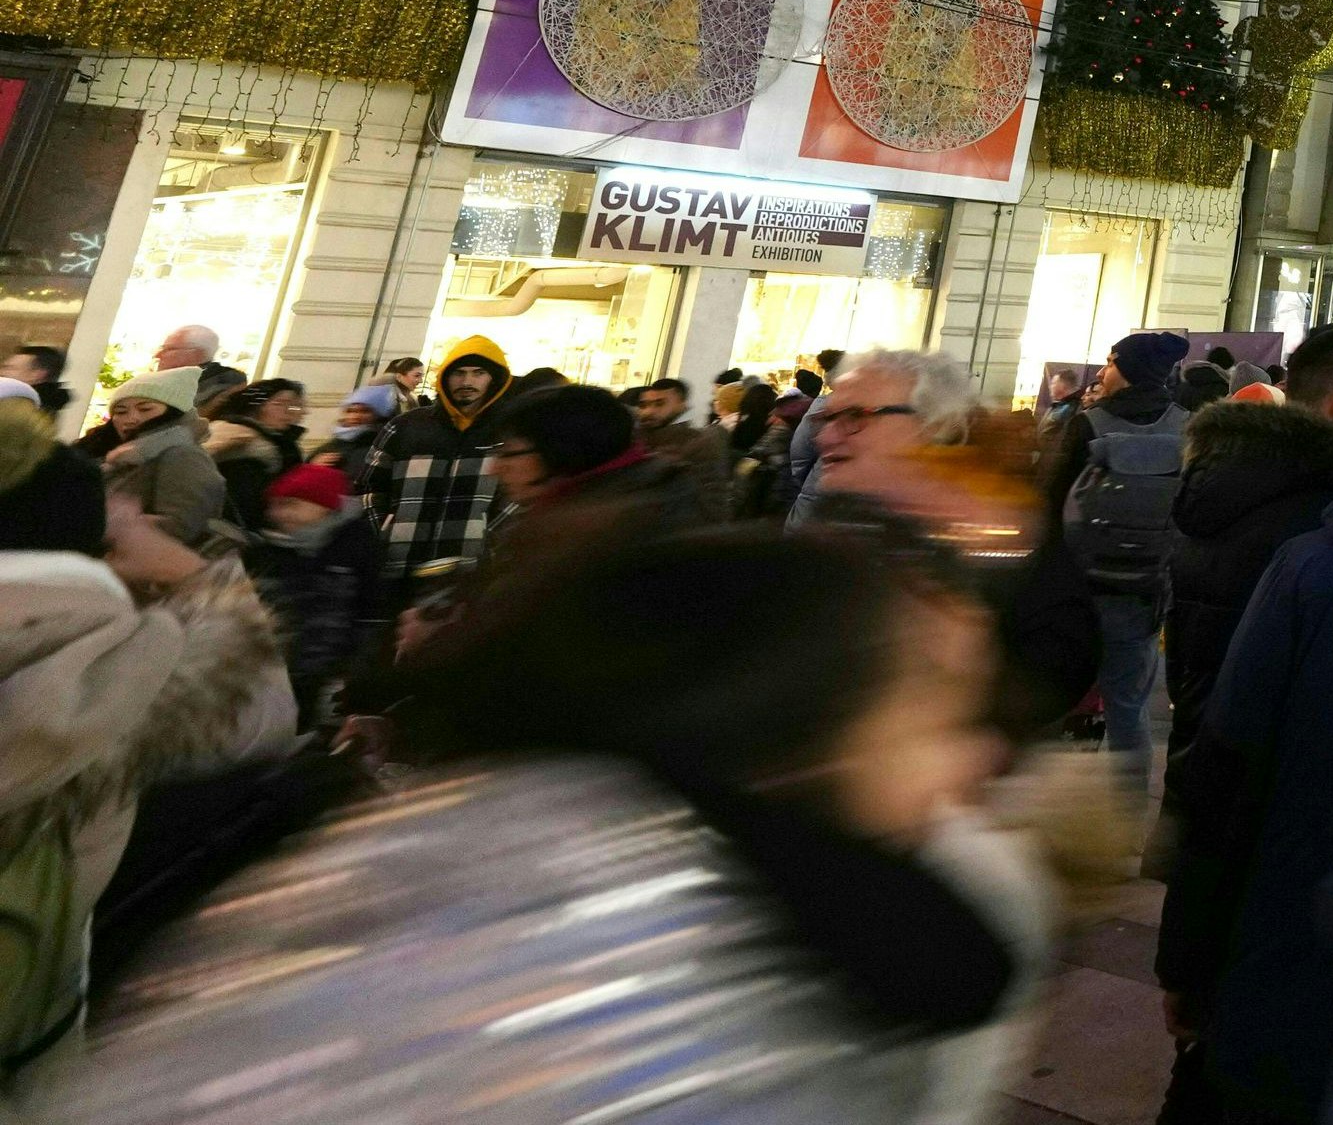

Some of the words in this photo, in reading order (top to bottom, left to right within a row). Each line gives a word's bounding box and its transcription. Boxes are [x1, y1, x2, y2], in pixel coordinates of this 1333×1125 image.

[600, 180, 754, 221] GUSTAV
[760, 195, 851, 218] INSPIRATIONS
[757, 212, 864, 233] REPRODUCTIONS
[590, 213, 749, 257] KLIMT
[754, 229, 820, 245] ANTIQUES
[751, 245, 823, 263] EXHIBITION
